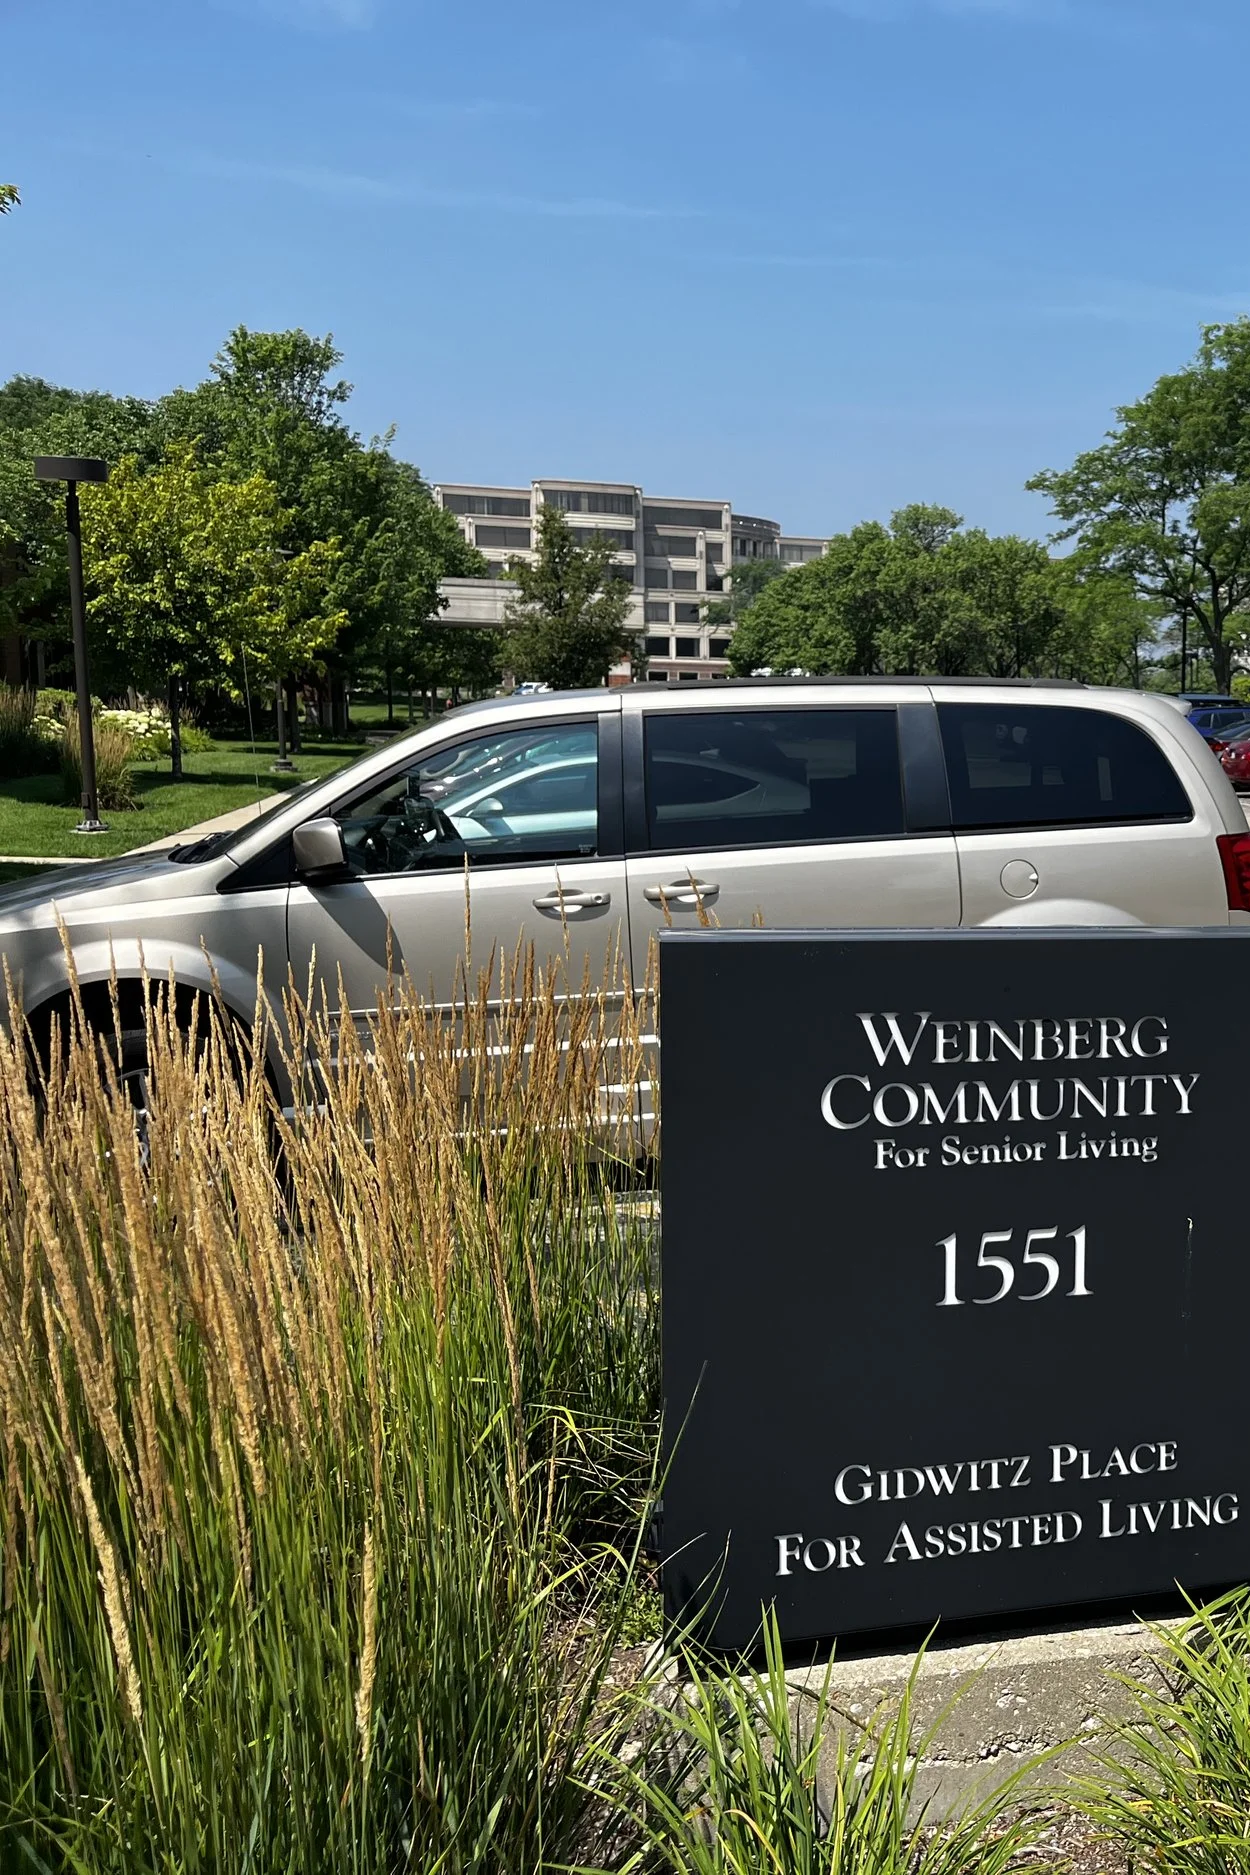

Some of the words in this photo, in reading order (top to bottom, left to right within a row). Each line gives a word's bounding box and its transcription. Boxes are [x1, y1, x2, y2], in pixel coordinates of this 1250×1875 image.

[855, 1011, 1170, 1067] WEINBERG
[820, 1073, 1200, 1130] COMMUNITY
[873, 1138, 930, 1170] For
[941, 1135, 1047, 1166] Senior
[1056, 1130, 1159, 1163] Living
[935, 1224, 1094, 1306] 1551
[834, 1455, 1031, 1505] GIDWITZ
[1048, 1441, 1178, 1483] PLACE
[774, 1533, 866, 1576] FOR
[883, 1511, 1083, 1564] ASSISTED
[1098, 1493, 1239, 1539] LIVING
